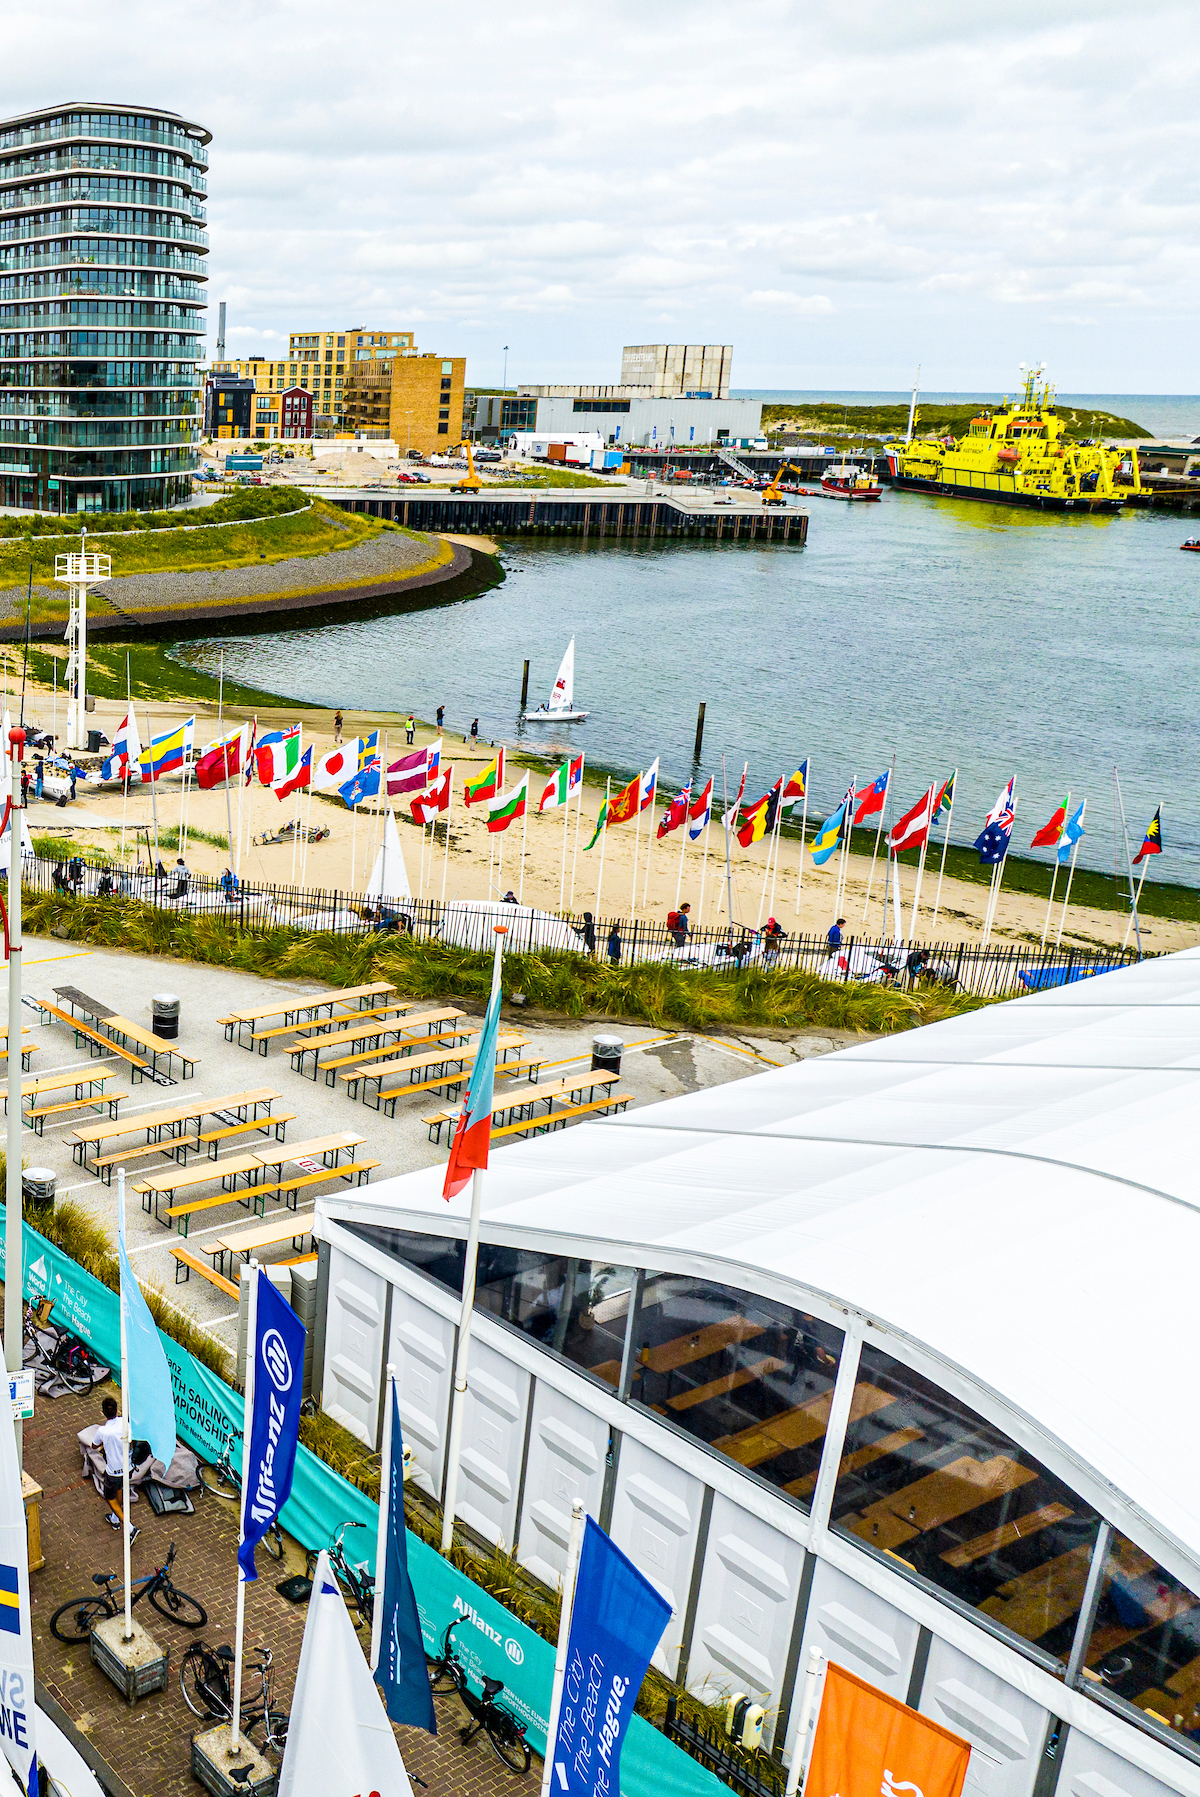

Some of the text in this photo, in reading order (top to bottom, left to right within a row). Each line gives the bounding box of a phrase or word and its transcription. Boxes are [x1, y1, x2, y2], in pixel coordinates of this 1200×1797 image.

[29, 1273, 46, 1293] World
[64, 1280, 89, 1307] The City
[61, 1303, 72, 1318] The
[62, 1292, 92, 1324] The Beach
[172, 1395, 236, 1453] MPIONSHIPS
[188, 1389, 229, 1431] SAILING
[250, 1391, 286, 1525] Allianz
[452, 1594, 503, 1648] Allianz
[459, 1640, 482, 1666] The City
[503, 1685, 515, 1700] DEN
[514, 1694, 531, 1713] HAAG
[558, 1647, 584, 1754] The City
[573, 1652, 605, 1784] The Beach
[596, 1674, 630, 1768] Hague.
